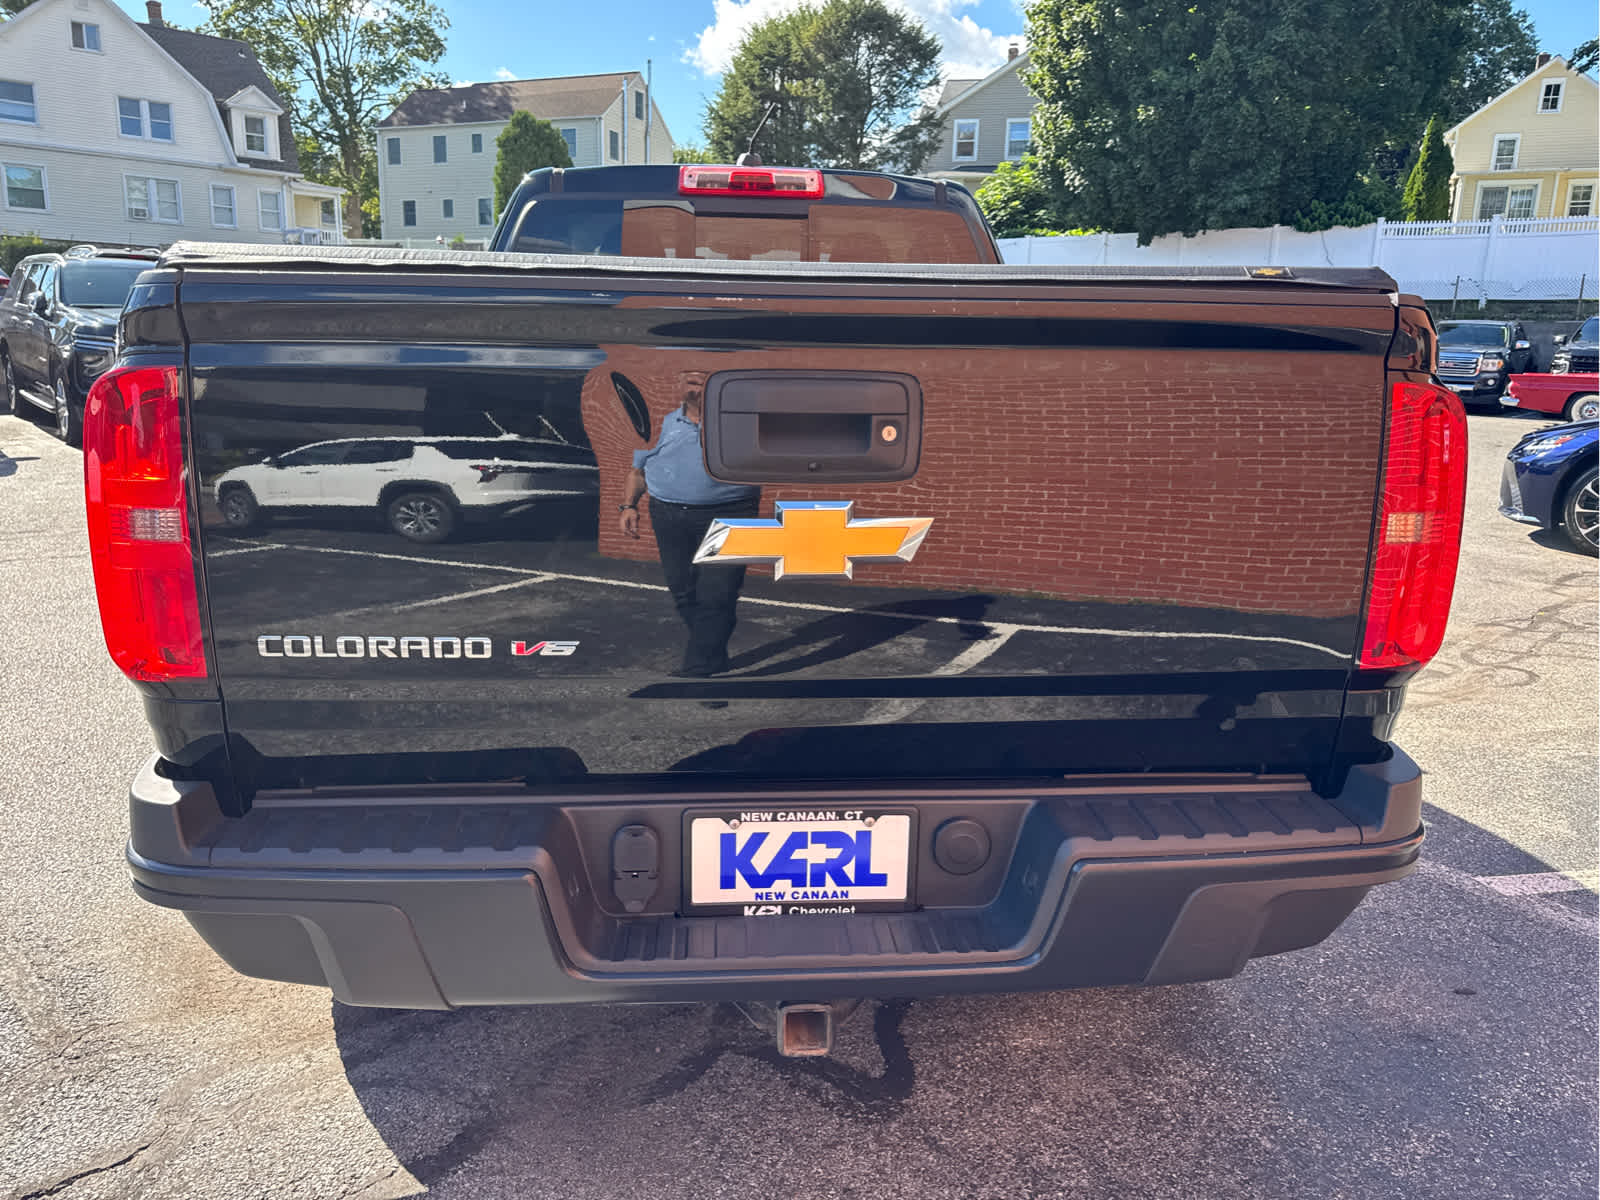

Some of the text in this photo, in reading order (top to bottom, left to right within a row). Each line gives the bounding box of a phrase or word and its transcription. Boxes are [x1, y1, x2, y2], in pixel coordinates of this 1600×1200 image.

[257, 635, 580, 659] COLORADO V6
[741, 812, 773, 822] NEW
[844, 811, 863, 820] CT
[720, 830, 888, 889] KARL
[755, 890, 849, 900] NEW CANAAN
[789, 905, 855, 915] Chevrolet
